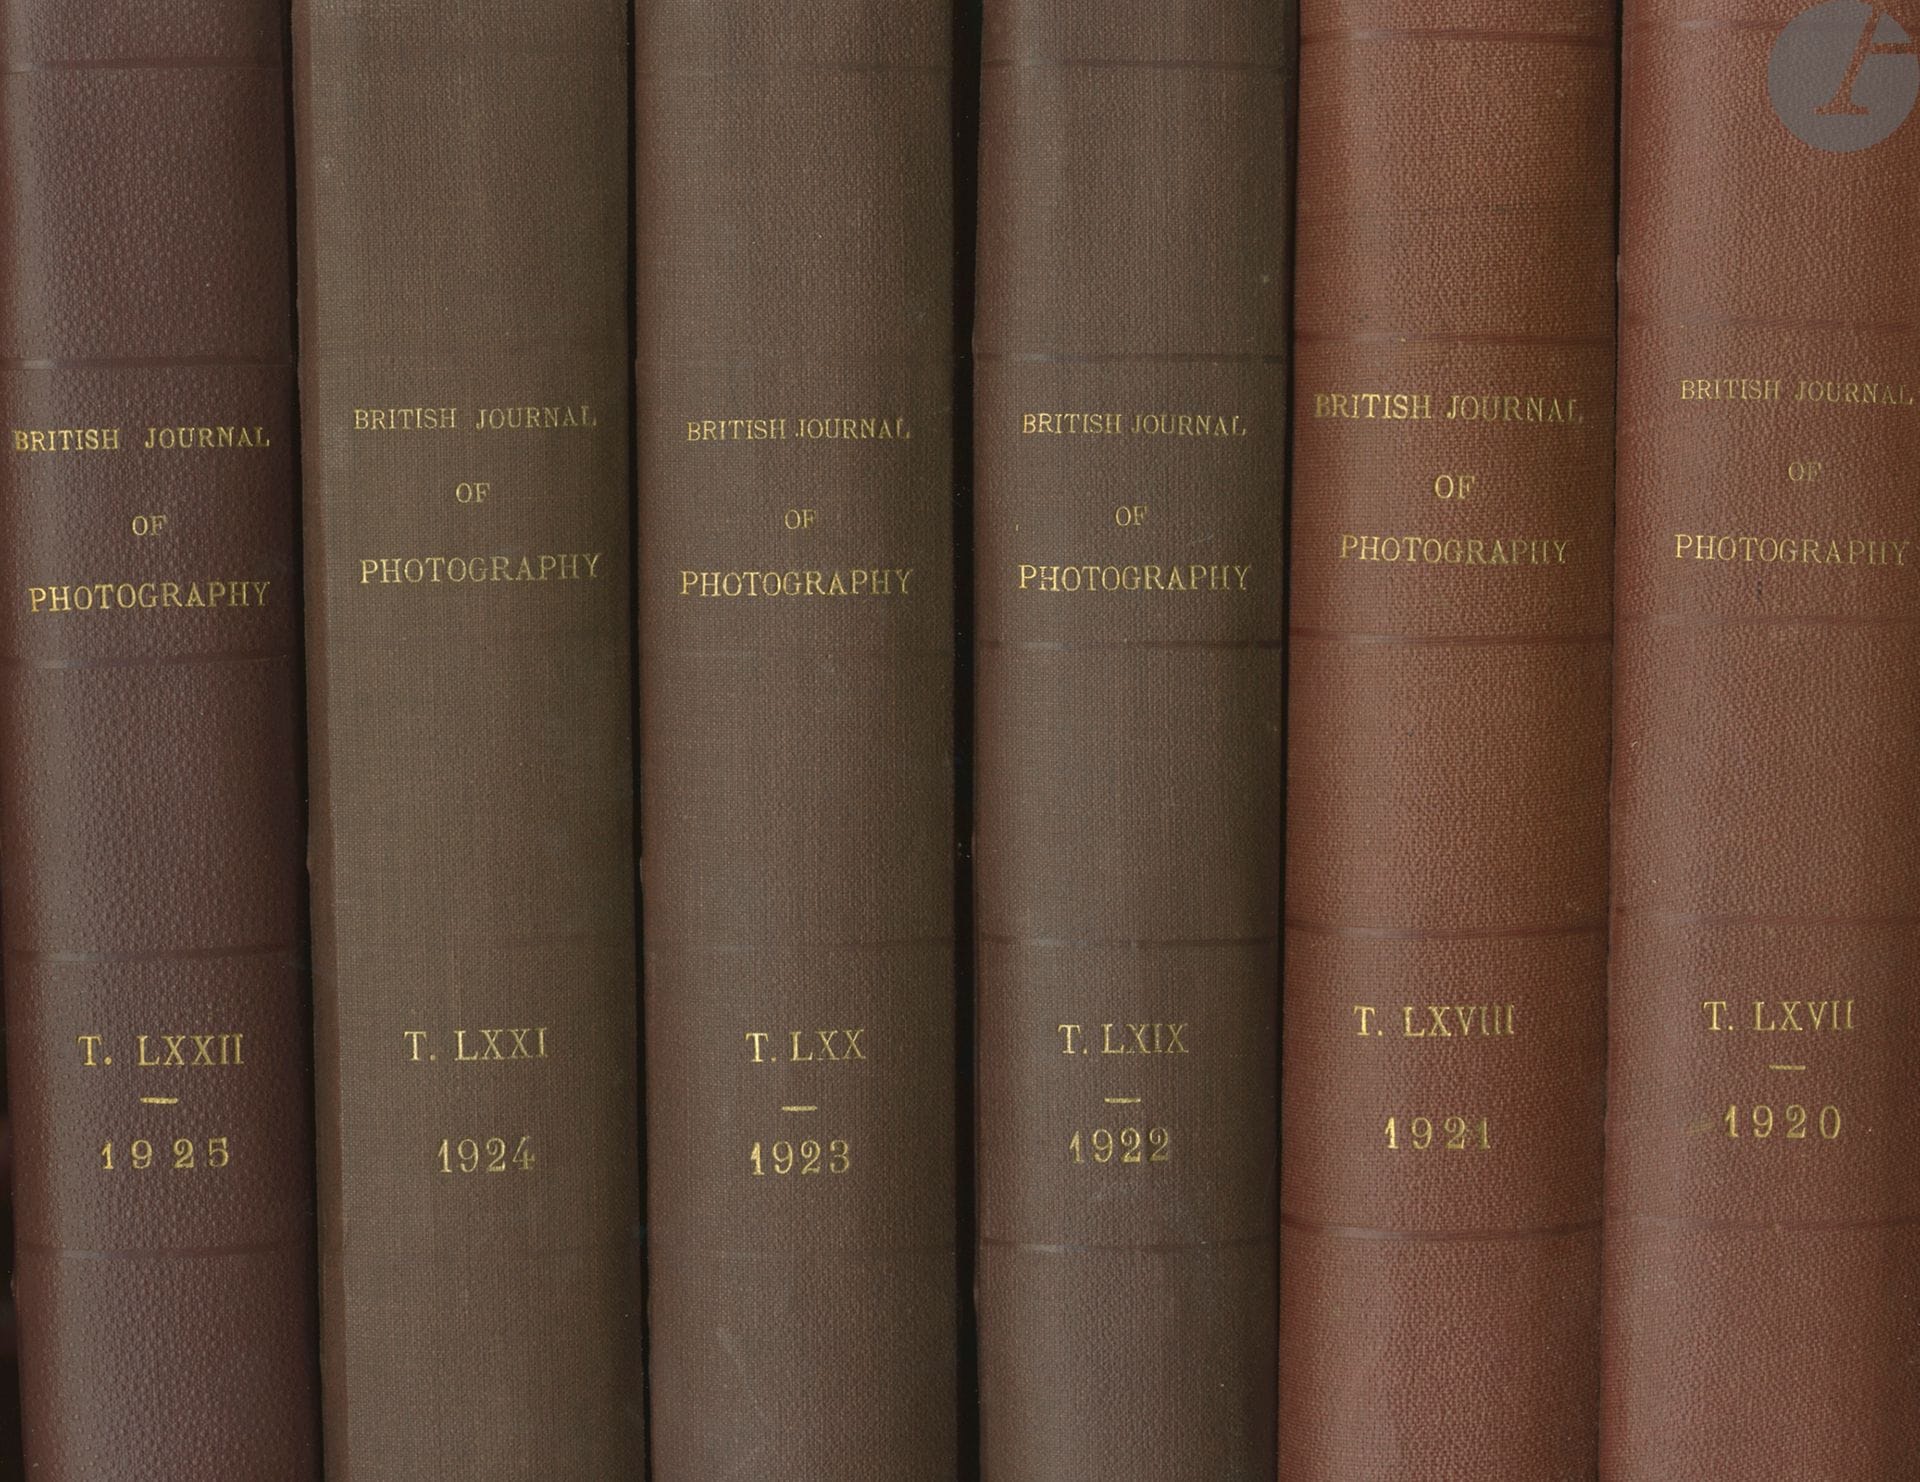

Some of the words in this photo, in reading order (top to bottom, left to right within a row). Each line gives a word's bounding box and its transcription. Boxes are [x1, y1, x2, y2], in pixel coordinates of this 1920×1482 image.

[1314, 392, 1431, 420] BRITISH
[1680, 378, 1781, 400] BRITISH
[1795, 380, 1914, 405] JOURNAL
[354, 407, 457, 430] BRITISH
[476, 405, 597, 431] JOURNAL
[686, 418, 786, 442] BRITISH
[795, 417, 910, 440] JOURNAL
[1022, 412, 1122, 435] BRITISH
[1131, 414, 1247, 437] JOURNAL
[13, 427, 120, 452] BRITISH
[144, 425, 270, 449] JOURNAL
[1434, 474, 1476, 500] OF
[1788, 461, 1822, 482] OF
[455, 482, 490, 504] OF
[131, 513, 168, 537] OF
[784, 508, 817, 530] OF
[1115, 504, 1148, 527] OF
[1674, 532, 1910, 566] PHOTOGRAPHY
[360, 553, 600, 585] PHOTOGRAPHY
[678, 568, 913, 598] PHOTOGRAPHY
[1018, 563, 1250, 592] PHOTOGRAPHY
[28, 580, 270, 613] PHOTOGRAPHY
[1354, 1004, 1383, 1036] T.
[1403, 1004, 1515, 1037] LXVIII
[1703, 1000, 1734, 1031] T.
[1754, 999, 1854, 1031] LXVII
[78, 1035, 113, 1066] T.
[137, 1034, 244, 1067] LXXII
[404, 1030, 437, 1061] T.
[453, 1027, 548, 1061] LXXI
[745, 1031, 777, 1064] T.
[789, 1028, 866, 1062] LXX
[1058, 1023, 1088, 1055] T.
[1101, 1023, 1189, 1055] LXIX
[1384, 1116, 1491, 1151] 1921
[1724, 1104, 1841, 1139] 1920
[100, 1136, 230, 1172] 1925
[438, 1135, 536, 1173] 1924
[750, 1139, 851, 1176] 1923
[1069, 1127, 1170, 1164] 1922
